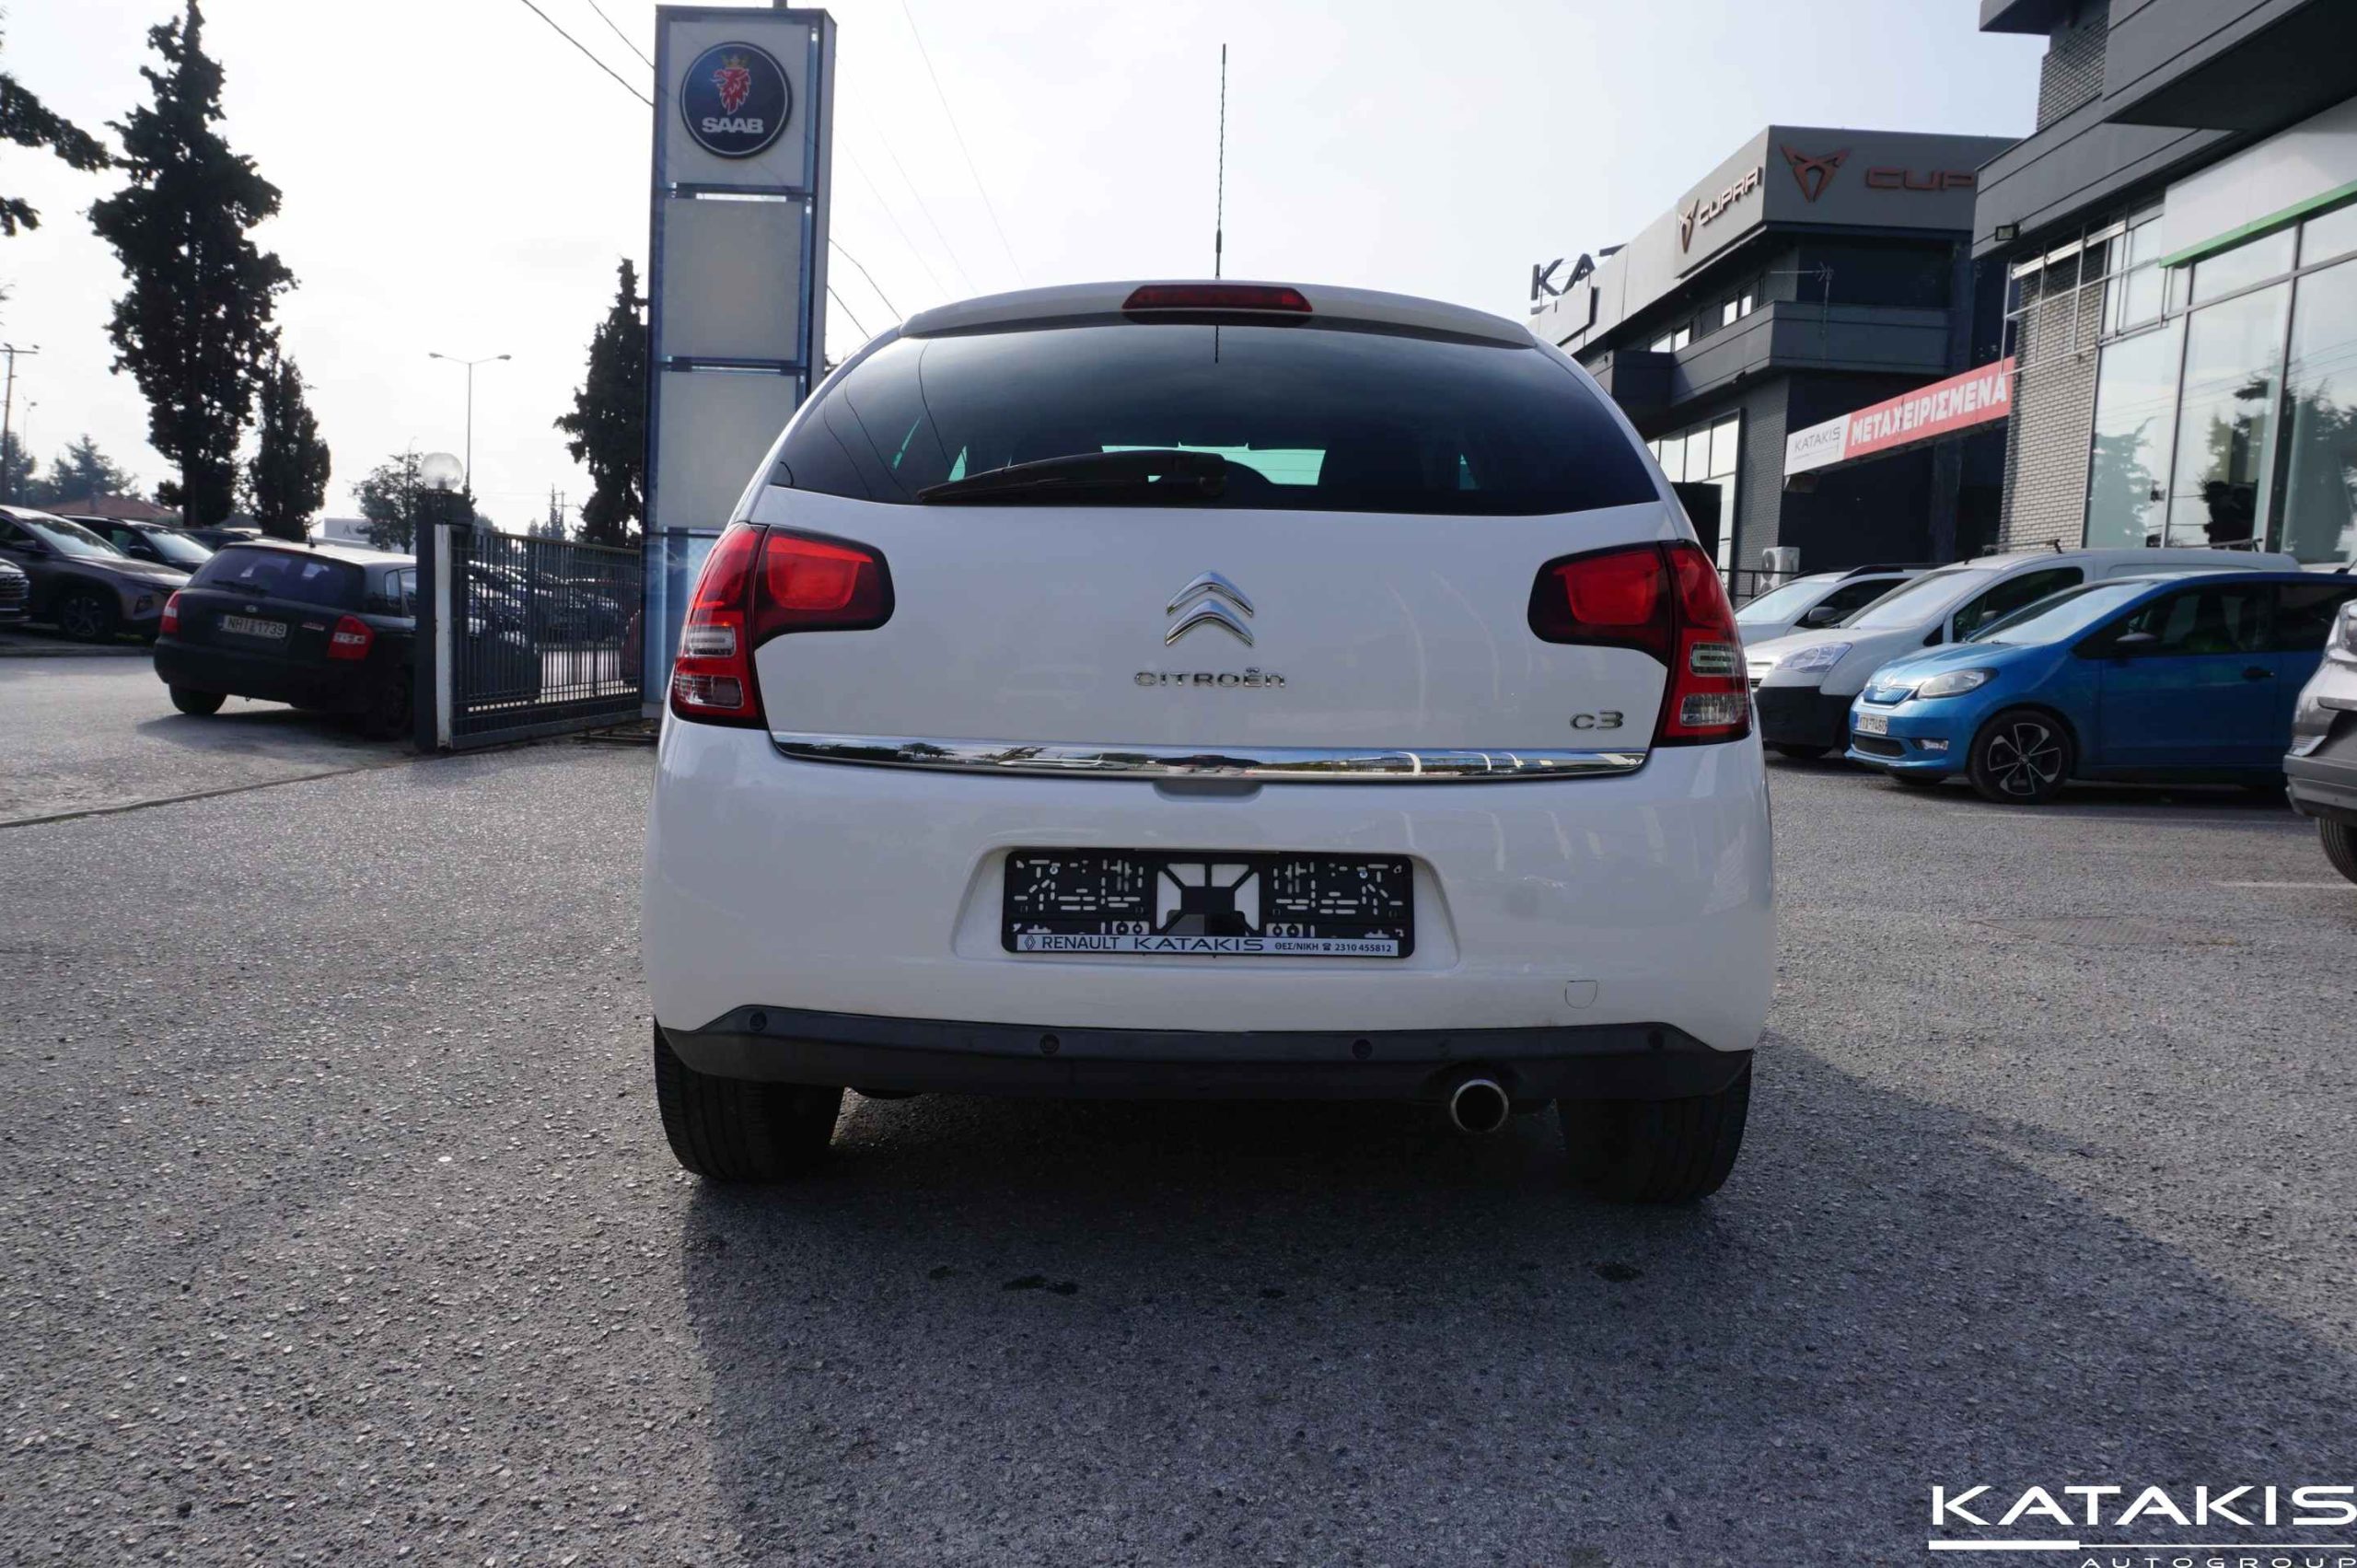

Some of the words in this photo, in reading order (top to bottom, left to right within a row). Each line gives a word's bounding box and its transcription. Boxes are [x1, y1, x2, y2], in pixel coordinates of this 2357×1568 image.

[702, 117, 764, 134] SAAB
[1699, 166, 1763, 226] CUPRA
[1530, 242, 1628, 301] KA
[1851, 374, 2008, 447] ΜΕΤΑΧΕΙΡΙΣΜΕΝΑ
[1794, 426, 1841, 452] KATAKIS
[1569, 710, 1624, 730] C3
[1041, 935, 1120, 949] RENAULT
[1134, 937, 1264, 952] KATAKIS
[1334, 943, 1358, 952] 2310
